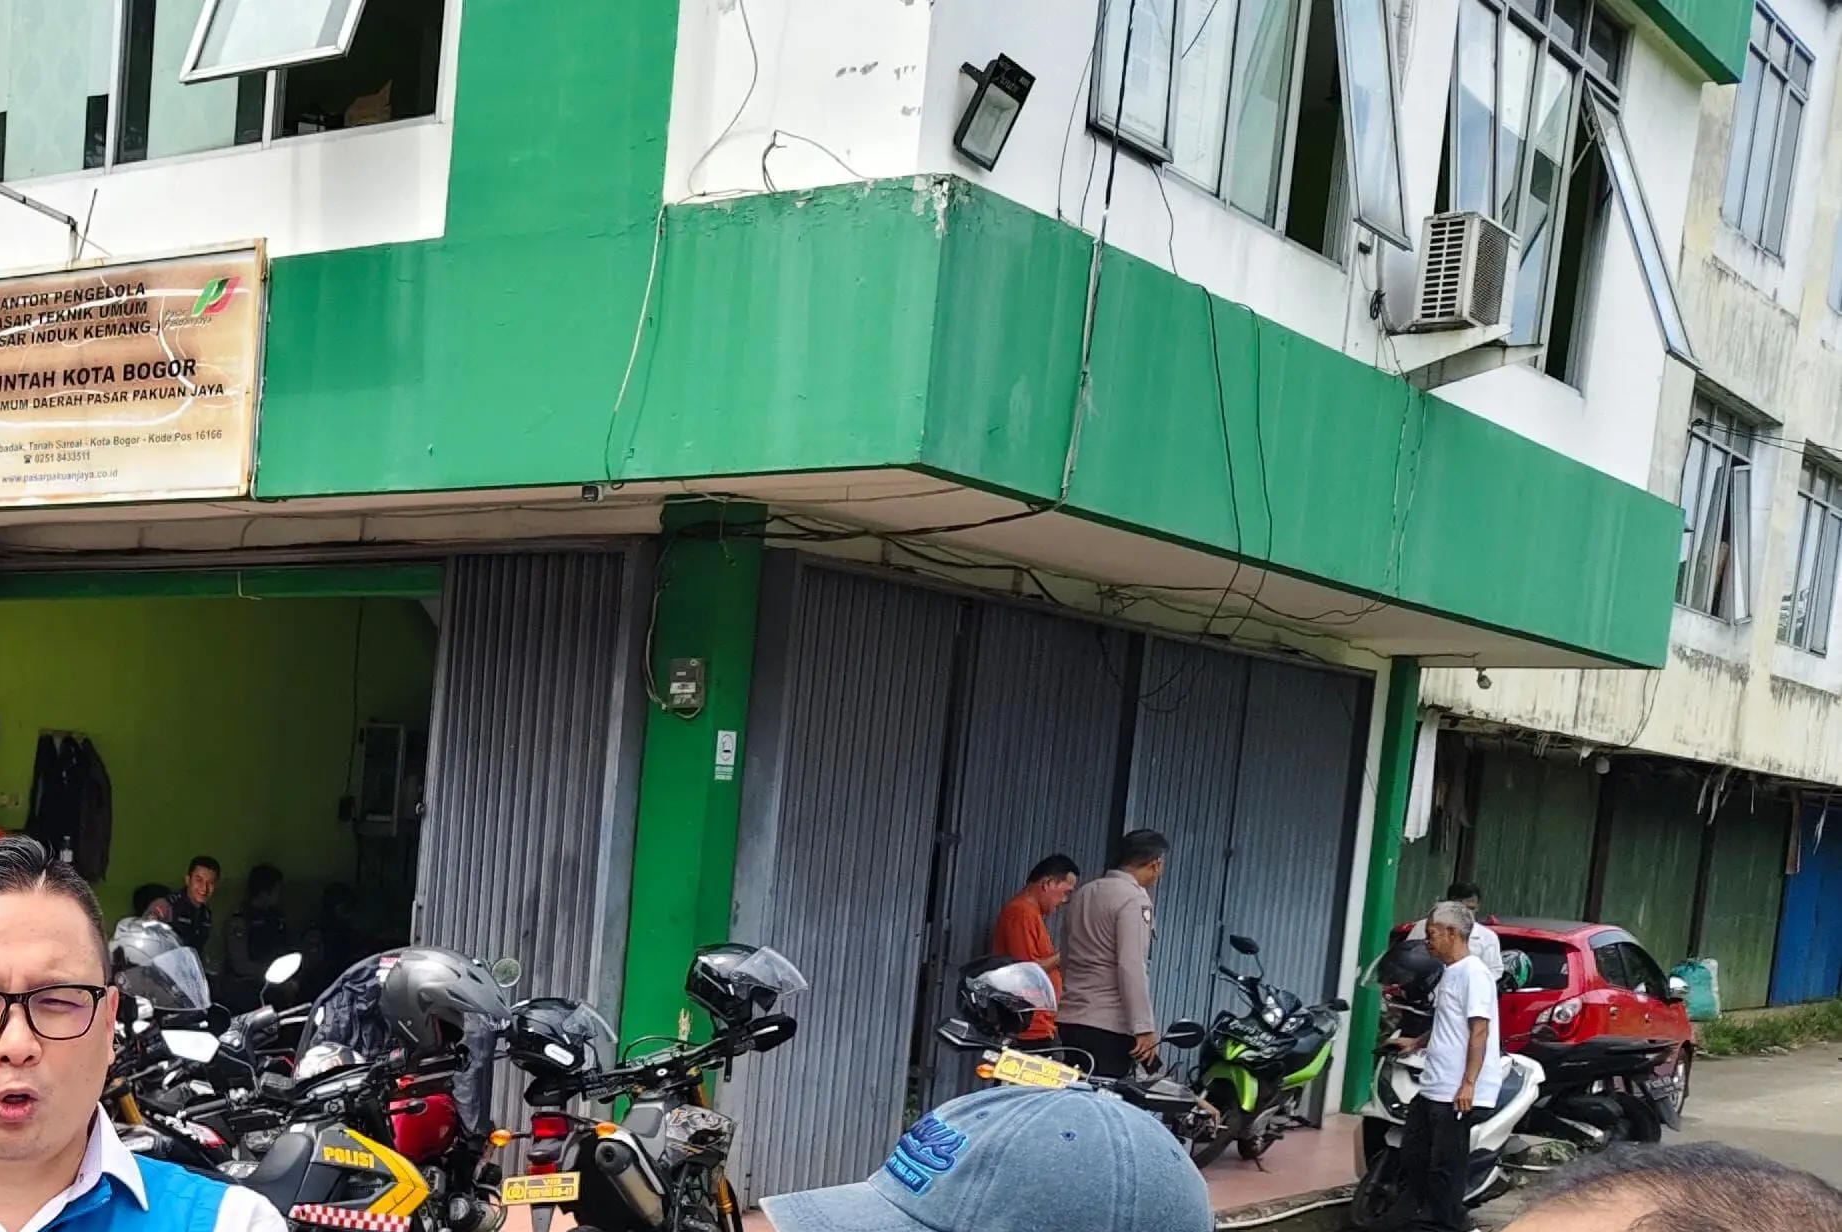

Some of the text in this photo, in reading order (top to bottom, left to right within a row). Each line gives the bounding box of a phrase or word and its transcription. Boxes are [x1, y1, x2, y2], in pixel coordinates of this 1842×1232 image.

[54, 282, 146, 305] PENGELOLA
[37, 306, 93, 325] TEKNIK
[99, 300, 148, 319] UMUM
[31, 323, 78, 343] INDUK
[83, 320, 151, 339] KEMANG
[62, 365, 116, 387] KOTA
[122, 358, 197, 383] BOGOR
[32, 394, 83, 410] DAERAH
[86, 391, 128, 405] PASAR
[132, 387, 186, 401] PAKUAN
[190, 383, 224, 397] JAYA
[29, 440, 54, 452] Tanah
[90, 436, 111, 447] Kota
[113, 434, 141, 448] Bogor
[148, 433, 172, 444] Kode
[174, 431, 192, 441] Pos
[322, 1146, 375, 1170] POLISI
